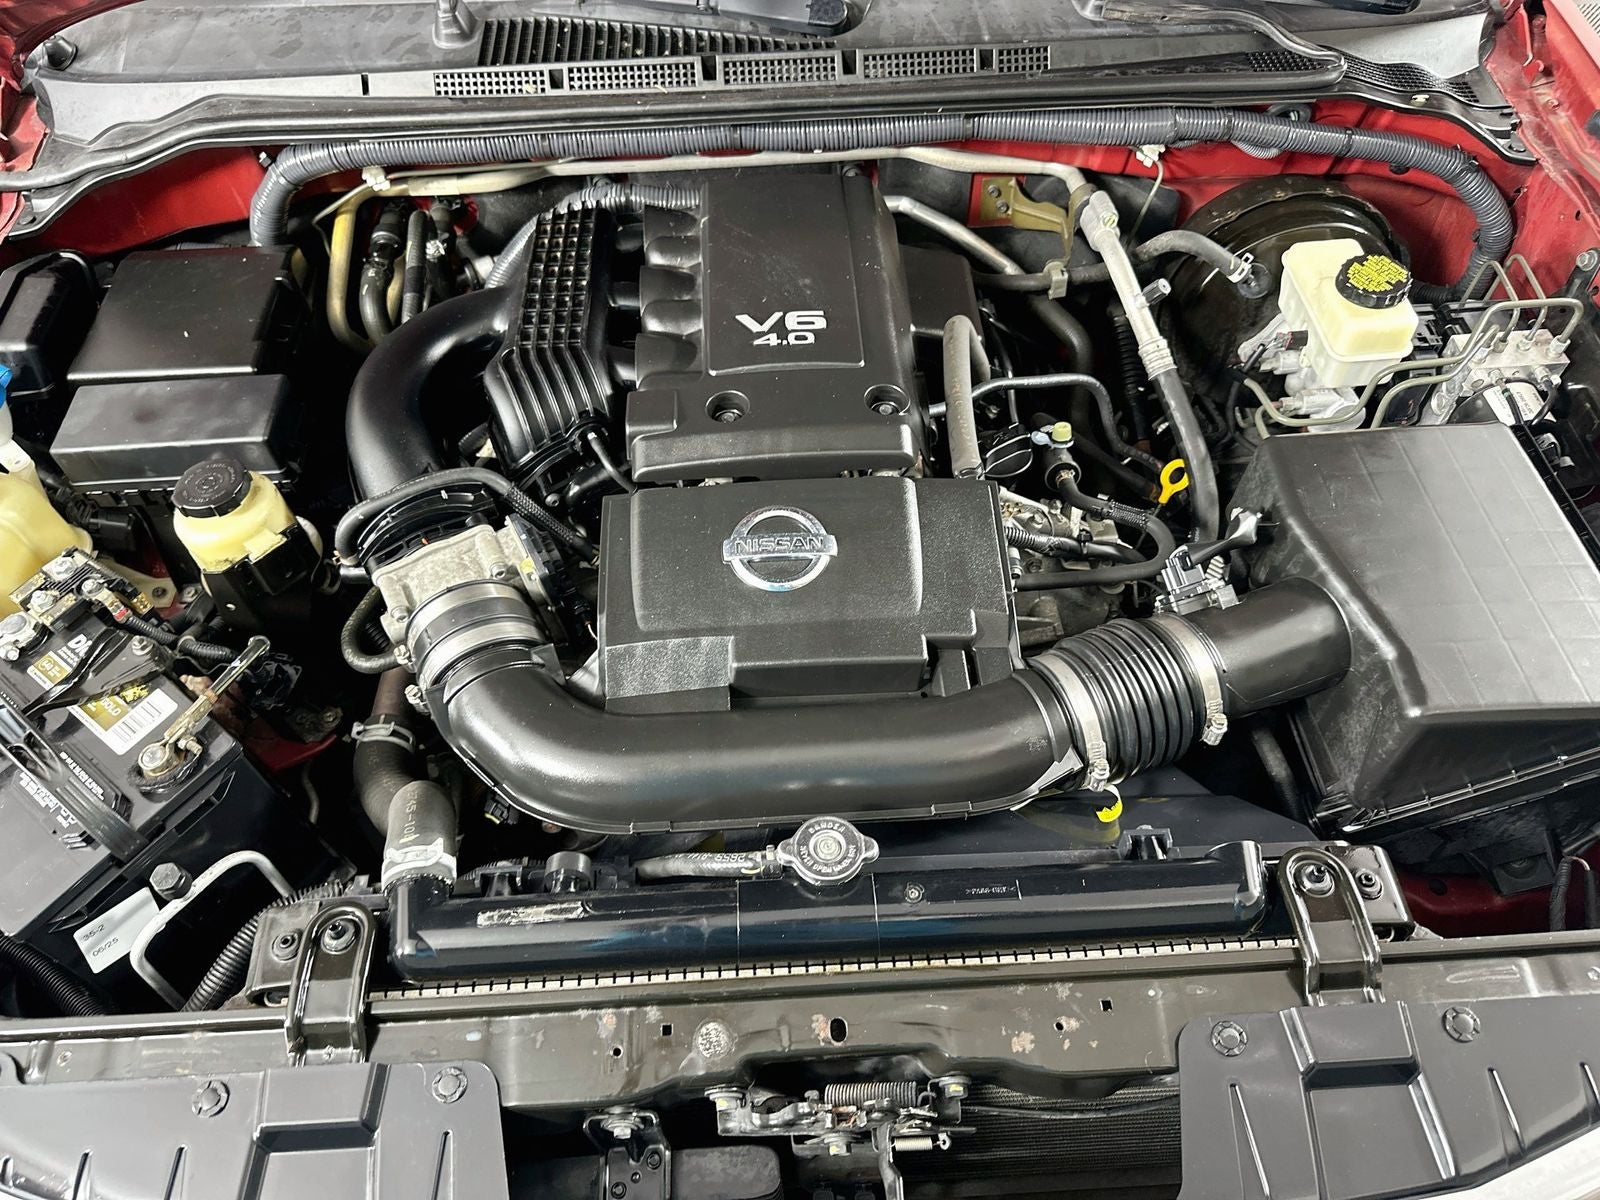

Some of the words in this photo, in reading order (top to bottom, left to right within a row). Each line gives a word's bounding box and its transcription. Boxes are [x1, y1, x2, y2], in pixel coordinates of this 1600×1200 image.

[735, 310, 827, 333] V6
[753, 331, 815, 346] 4.0
[735, 536, 823, 554] NISSAN
